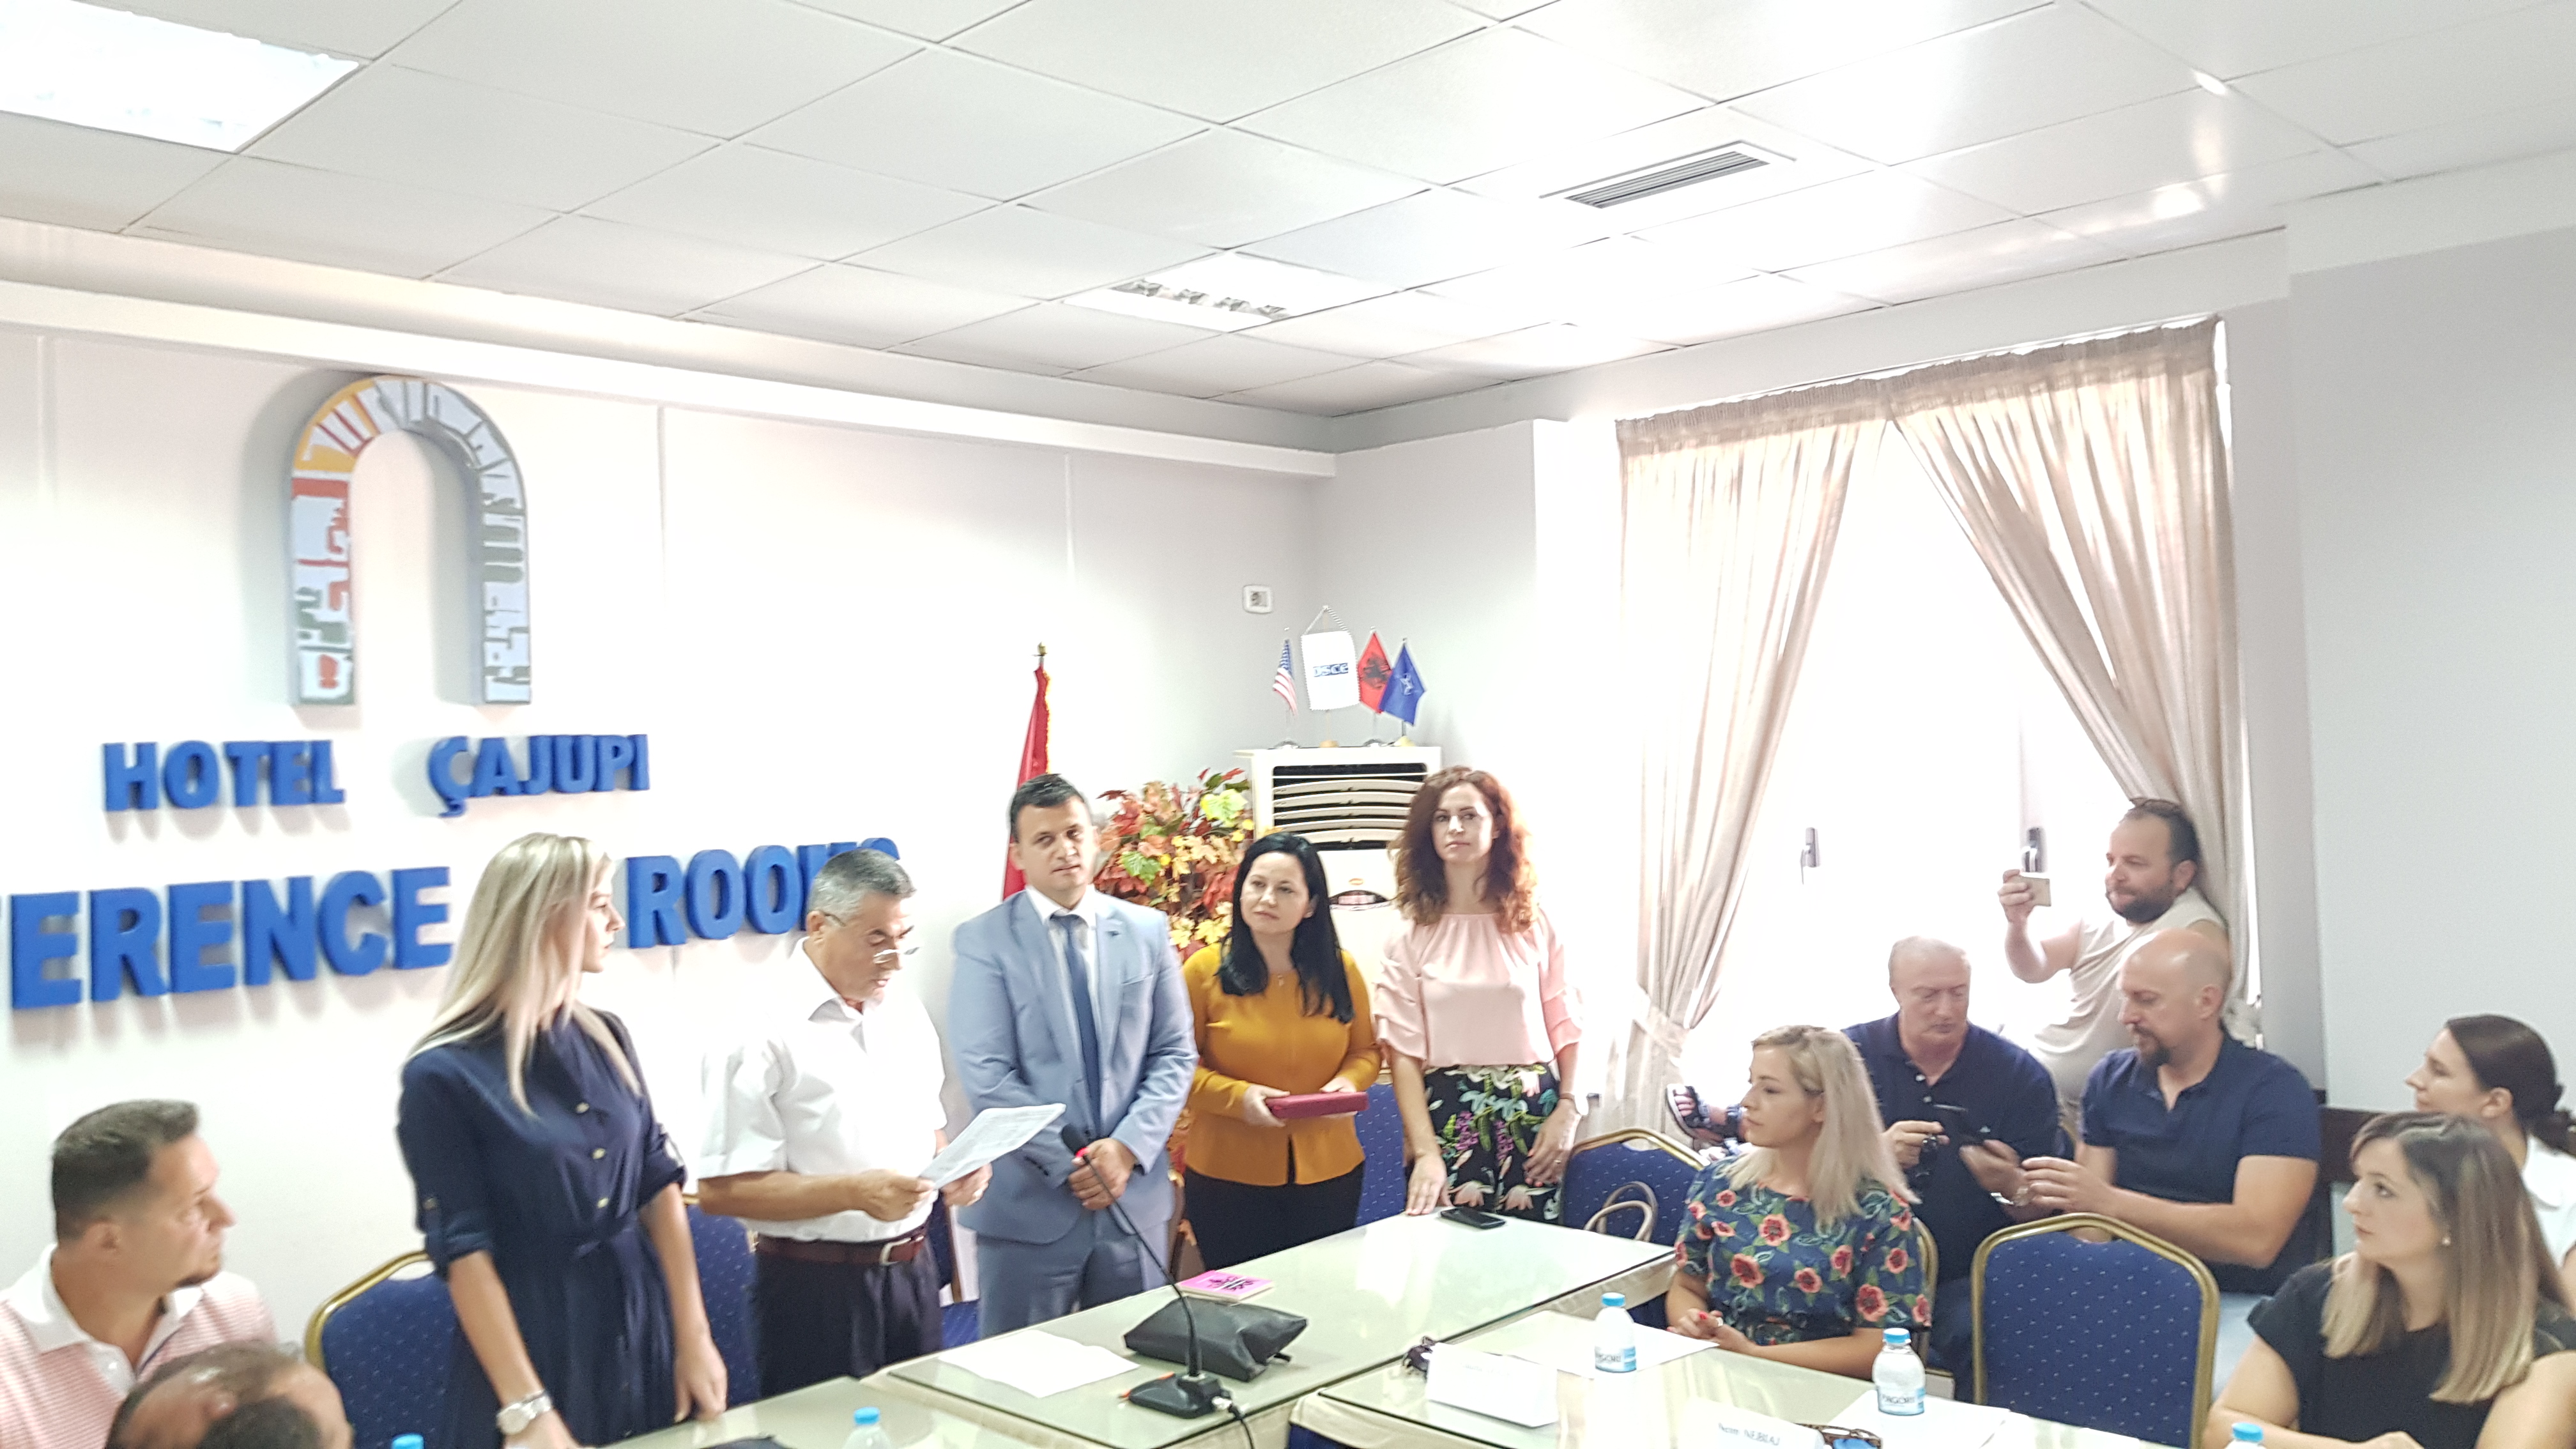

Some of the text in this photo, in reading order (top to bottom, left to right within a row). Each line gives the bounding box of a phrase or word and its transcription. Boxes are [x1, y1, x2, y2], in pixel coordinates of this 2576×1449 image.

[103, 733, 650, 817] HOTEL ÇAJUPI
[626, 838, 900, 949] ROO
